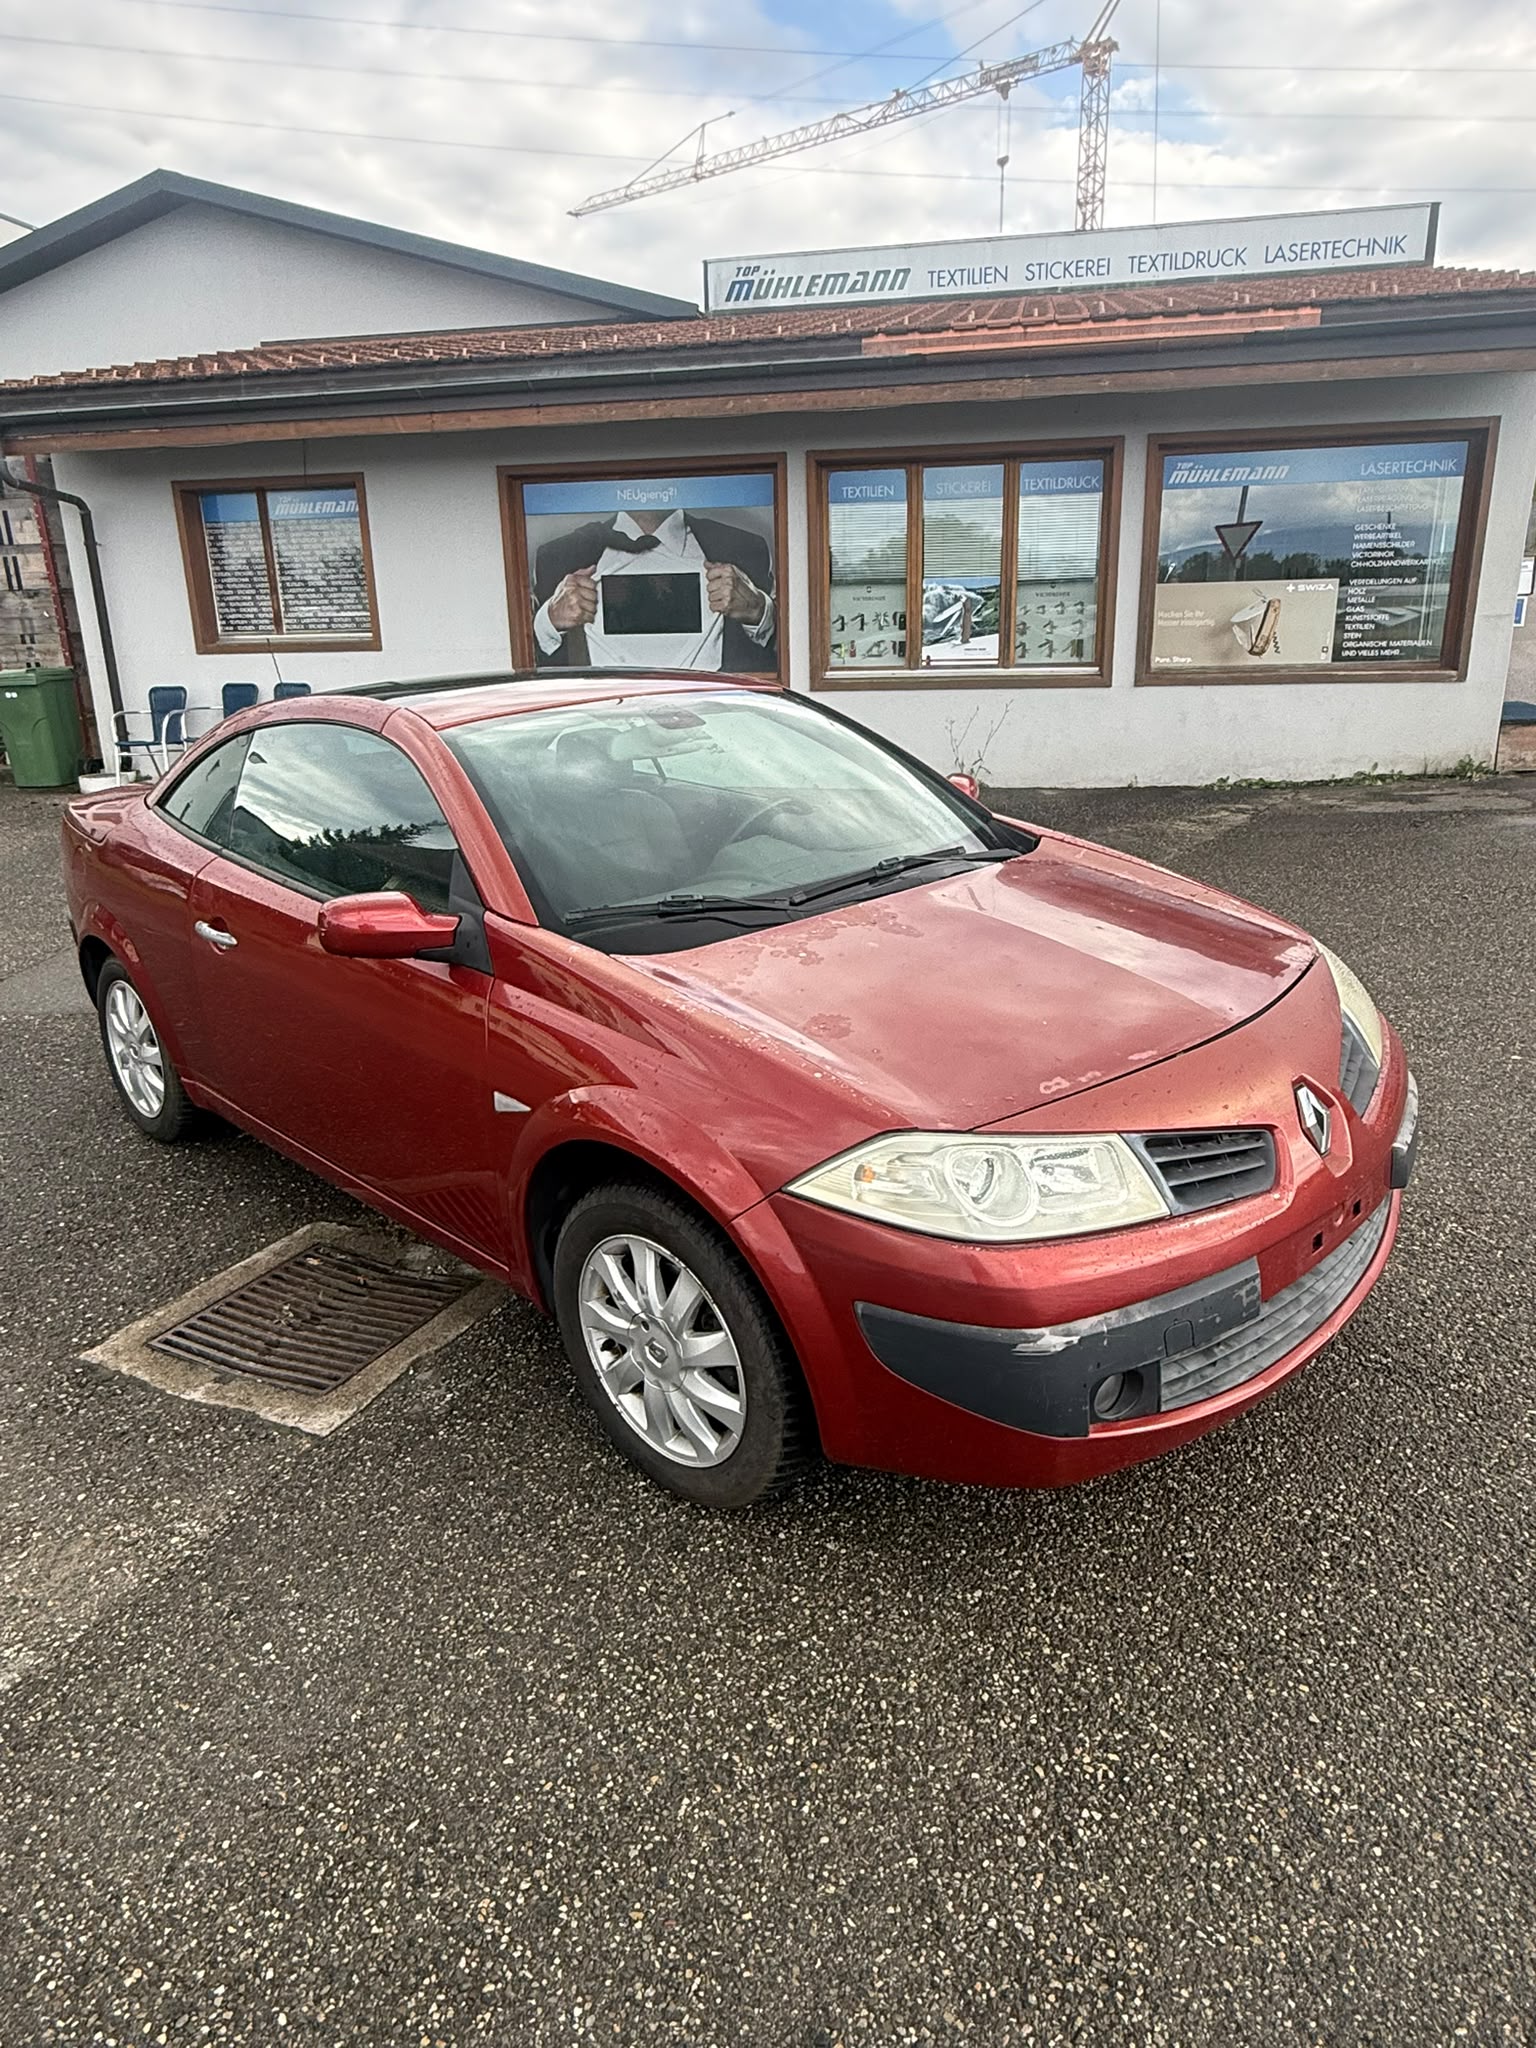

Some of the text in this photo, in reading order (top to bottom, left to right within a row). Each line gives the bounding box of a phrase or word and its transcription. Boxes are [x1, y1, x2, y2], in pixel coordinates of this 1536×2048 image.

[927, 234, 1408, 289] TEXTILIEN STICKEREI TEXTILDRUCK LASERTECHNIK
[736, 265, 761, 277] TOP
[725, 267, 911, 303] MÜHLEMANN
[1177, 462, 1194, 470] TOP
[1360, 459, 1457, 476] LASERTECHNIK
[1168, 465, 1290, 485] MÜHLEMANN
[1024, 475, 1099, 491] TEXTILDRUCK
[936, 480, 992, 495] STICKEREI
[842, 485, 894, 499] TEXTILIEN
[1354, 523, 1397, 531] GESCHENKE
[1353, 532, 1402, 540] WERBEARTIKEL
[1352, 540, 1416, 550] NAMENSSCHILDER
[1351, 551, 1395, 559] VICTORINOX
[1297, 583, 1335, 592] SWIZA
[1347, 587, 1367, 595] HOLZ
[1347, 596, 1375, 604] METALLE
[1346, 605, 1365, 613] GLAS
[1345, 614, 1390, 622] KUNSTSTOFFE
[1343, 632, 1362, 640] STEIN
[1342, 640, 1388, 648] ORGANISCHE
[1357, 649, 1379, 657] VIELES
